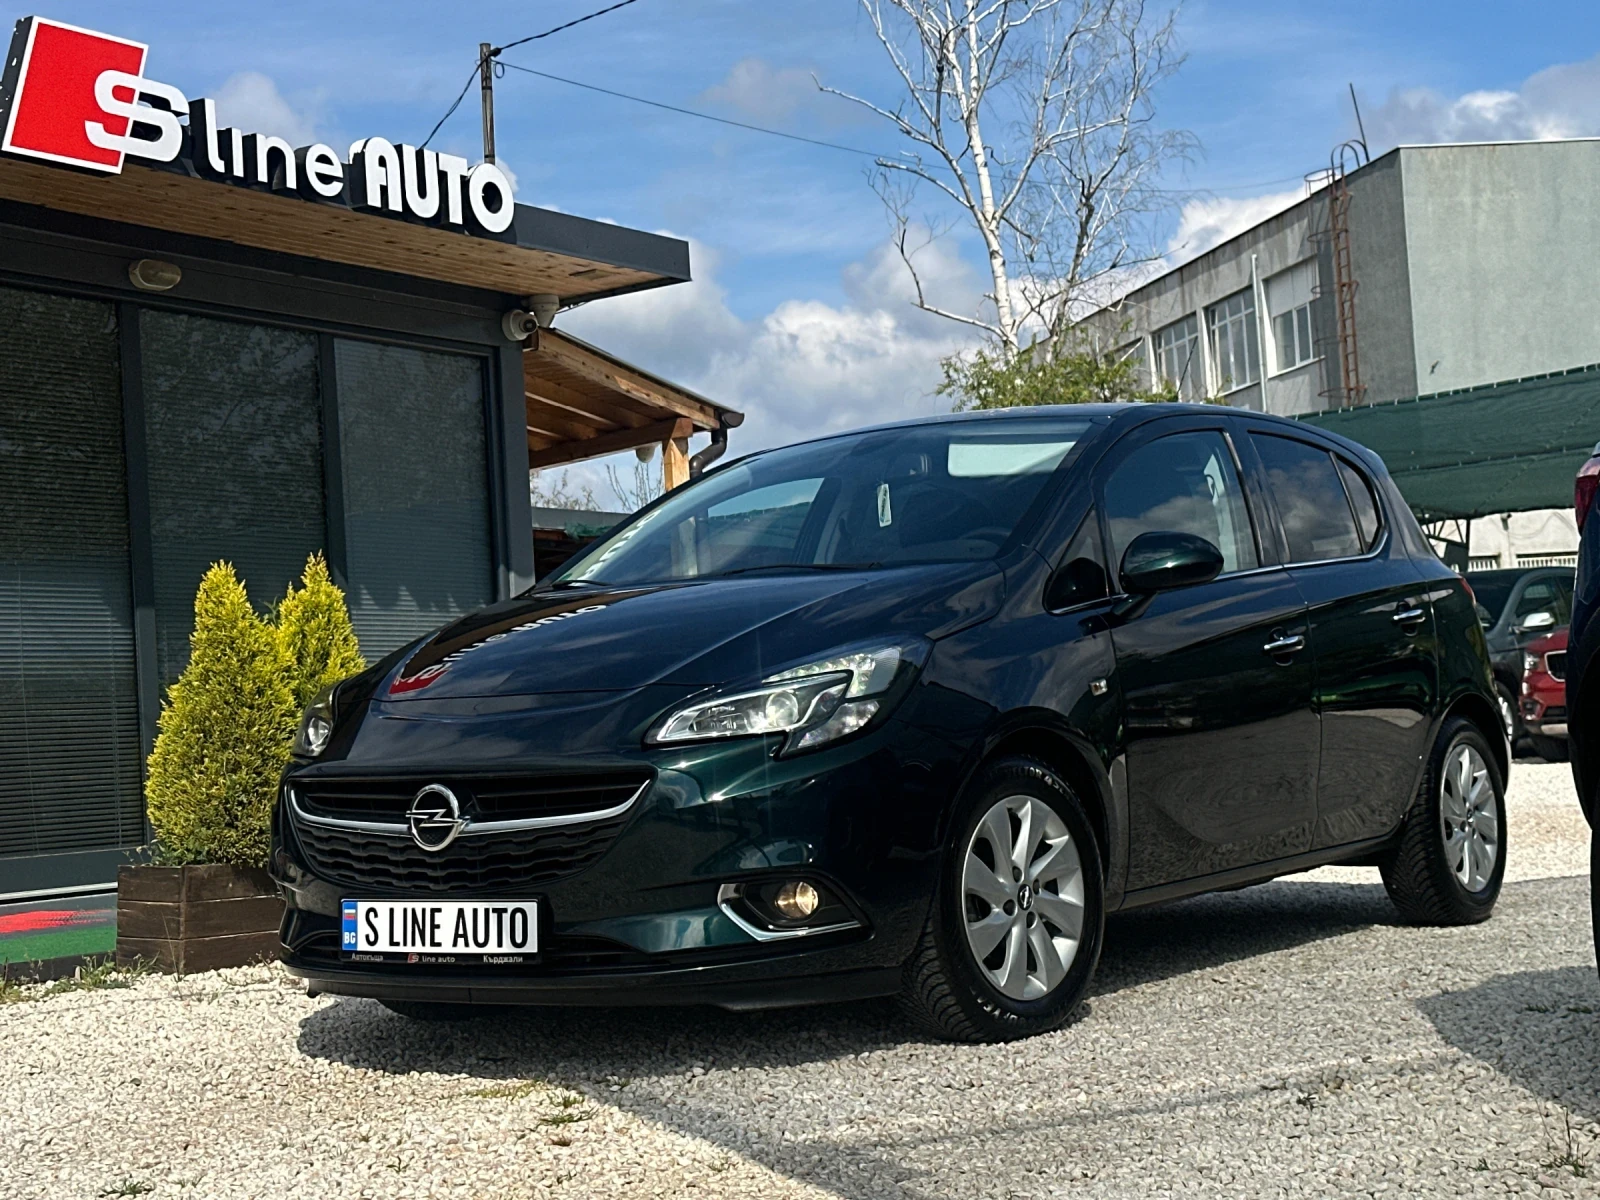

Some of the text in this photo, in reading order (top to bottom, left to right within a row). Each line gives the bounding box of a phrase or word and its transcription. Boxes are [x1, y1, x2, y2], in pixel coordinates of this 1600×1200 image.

[85, 69, 515, 233] S line AUTO
[365, 907, 529, 948] S LINE AUTO
[344, 931, 356, 945] BG
[422, 955, 436, 963] line
[483, 954, 523, 964] Кърджали
